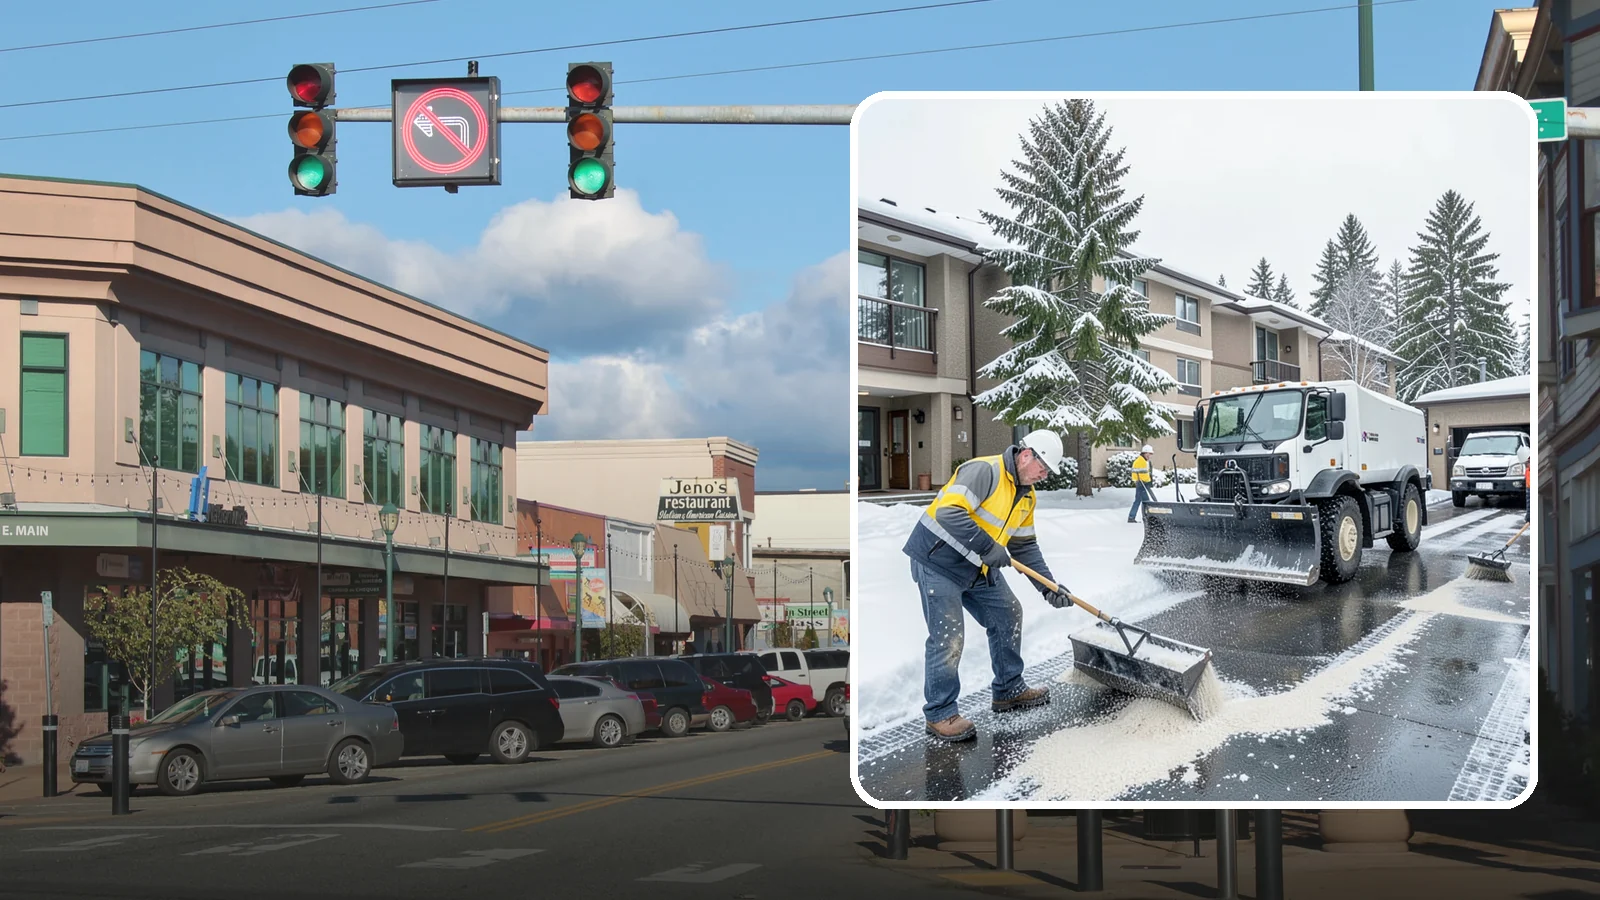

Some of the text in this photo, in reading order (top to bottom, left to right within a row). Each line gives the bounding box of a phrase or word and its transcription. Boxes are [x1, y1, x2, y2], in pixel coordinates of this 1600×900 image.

[669, 480, 727, 494] Jeno's
[665, 496, 731, 509] restaurant
[658, 510, 682, 520] Italian
[686, 510, 715, 520] American
[715, 510, 738, 519] Cuisine
[2, 525, 49, 536] E. MAIN
[797, 607, 828, 617] Street
[790, 619, 824, 627] lass
